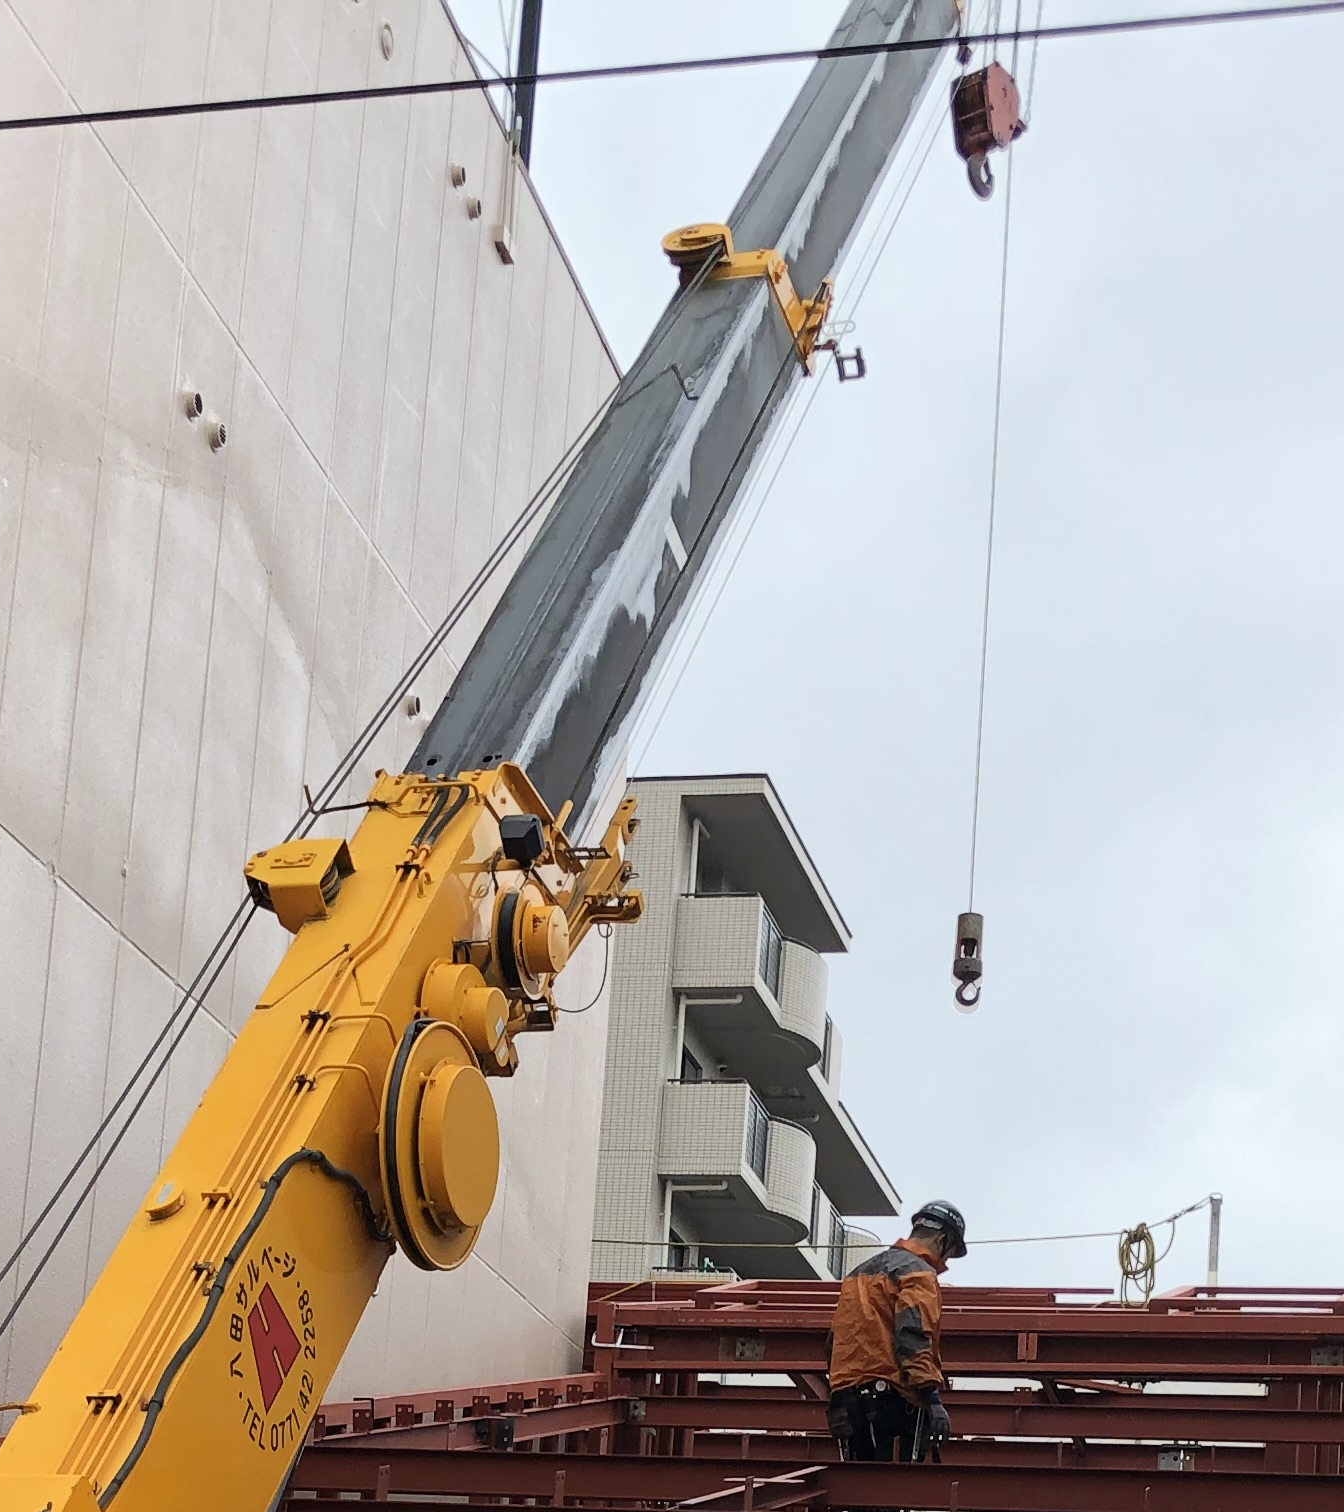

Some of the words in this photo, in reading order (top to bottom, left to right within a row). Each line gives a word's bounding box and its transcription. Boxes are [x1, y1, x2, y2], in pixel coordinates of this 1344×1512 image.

[230, 1246, 296, 1379] 八田サルベージ
